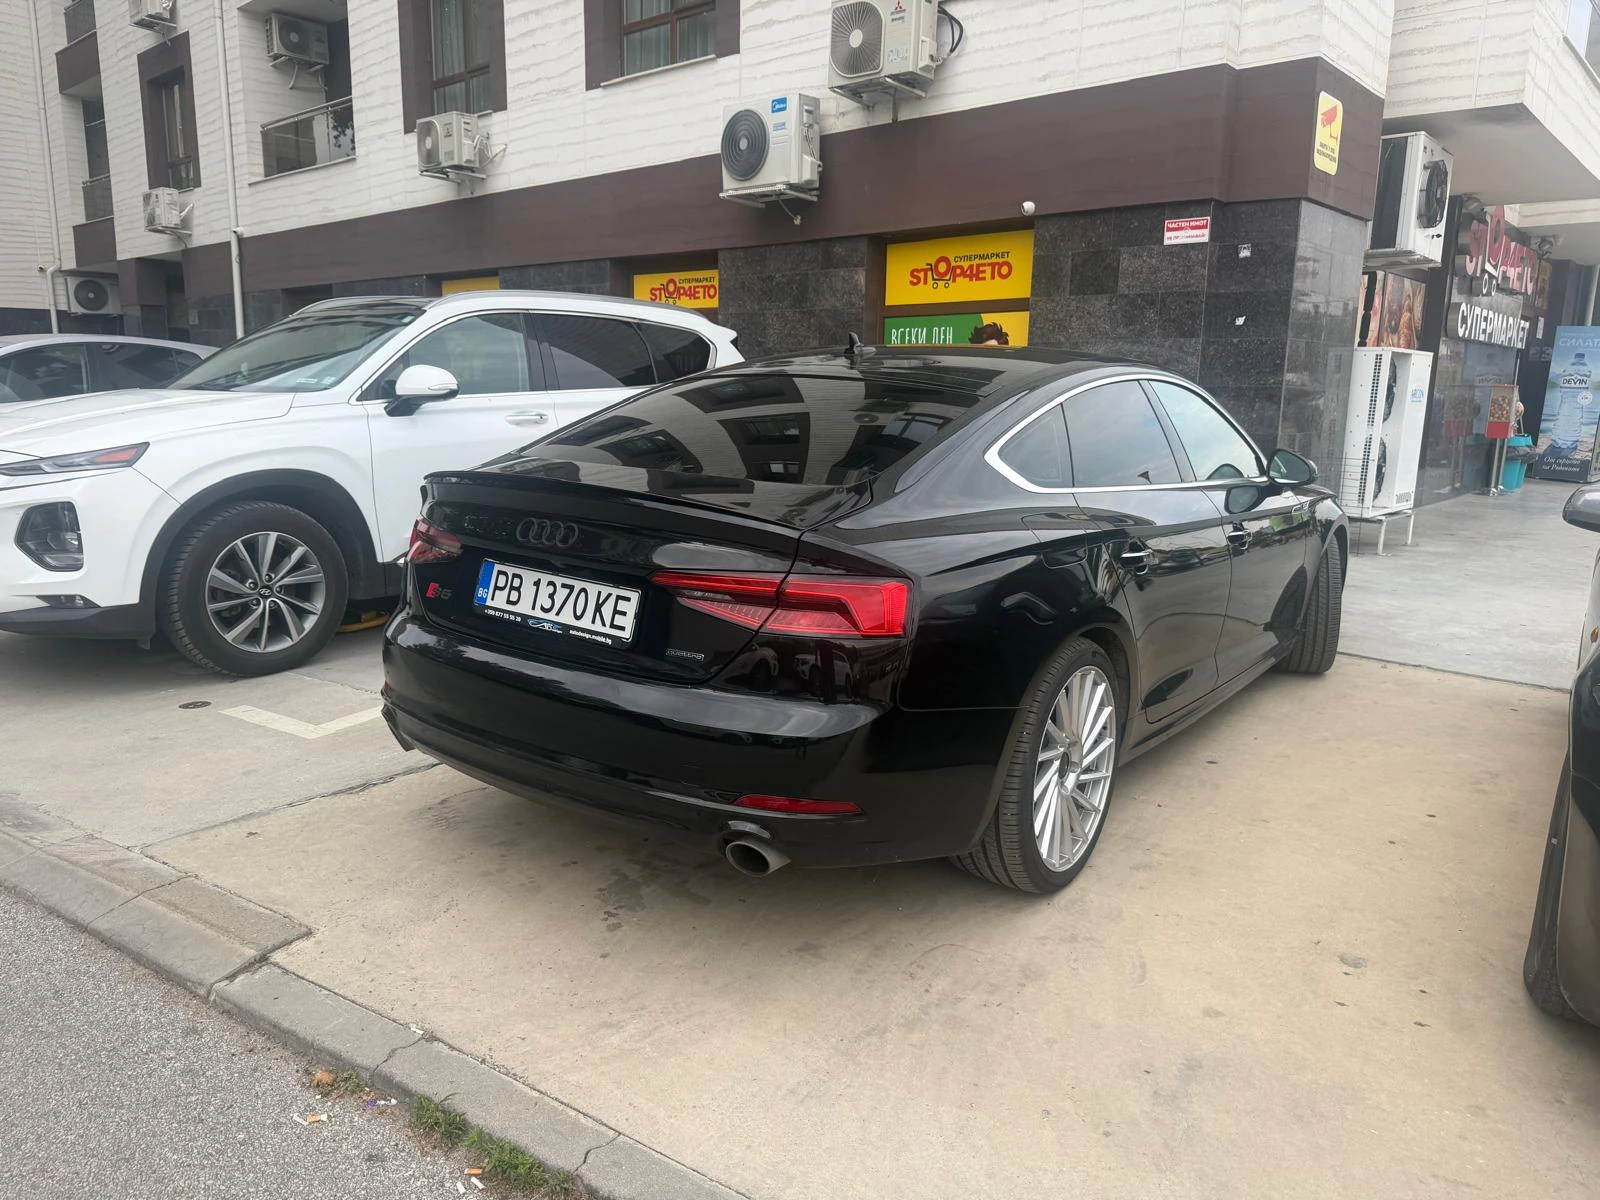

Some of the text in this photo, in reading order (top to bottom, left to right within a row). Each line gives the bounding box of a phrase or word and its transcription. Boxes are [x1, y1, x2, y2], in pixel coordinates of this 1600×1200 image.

[954, 251, 1010, 263] СУПЕРМАРКЕТ
[1458, 302, 1530, 349] СУПЕРМАРКЕТ
[891, 327, 927, 345] ВСЕКИ
[478, 588, 488, 598] BG
[490, 570, 632, 631] PB 1370 KE
